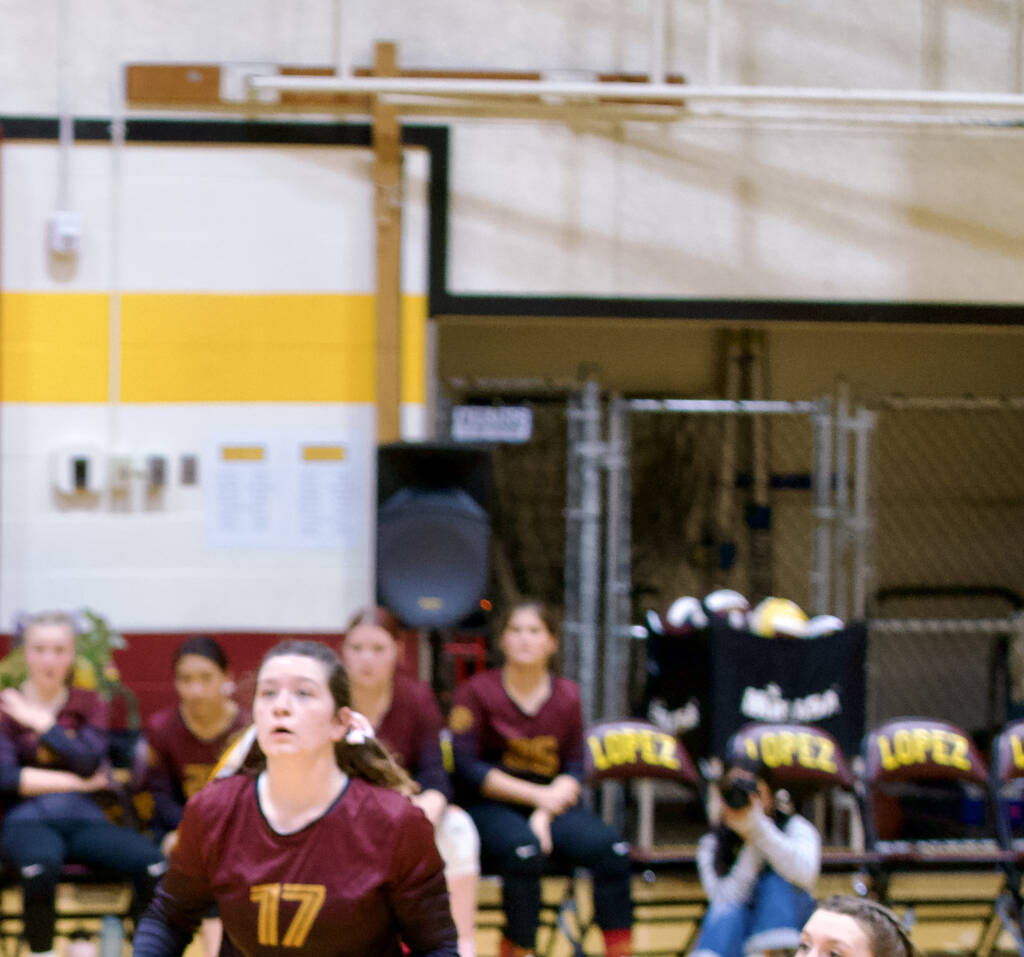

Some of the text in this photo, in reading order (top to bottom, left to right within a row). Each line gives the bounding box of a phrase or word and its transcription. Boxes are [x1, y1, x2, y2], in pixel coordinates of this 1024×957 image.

[587, 728, 680, 770] LOPEZ
[878, 728, 971, 771] LOPEZ
[249, 883, 326, 948] 17
